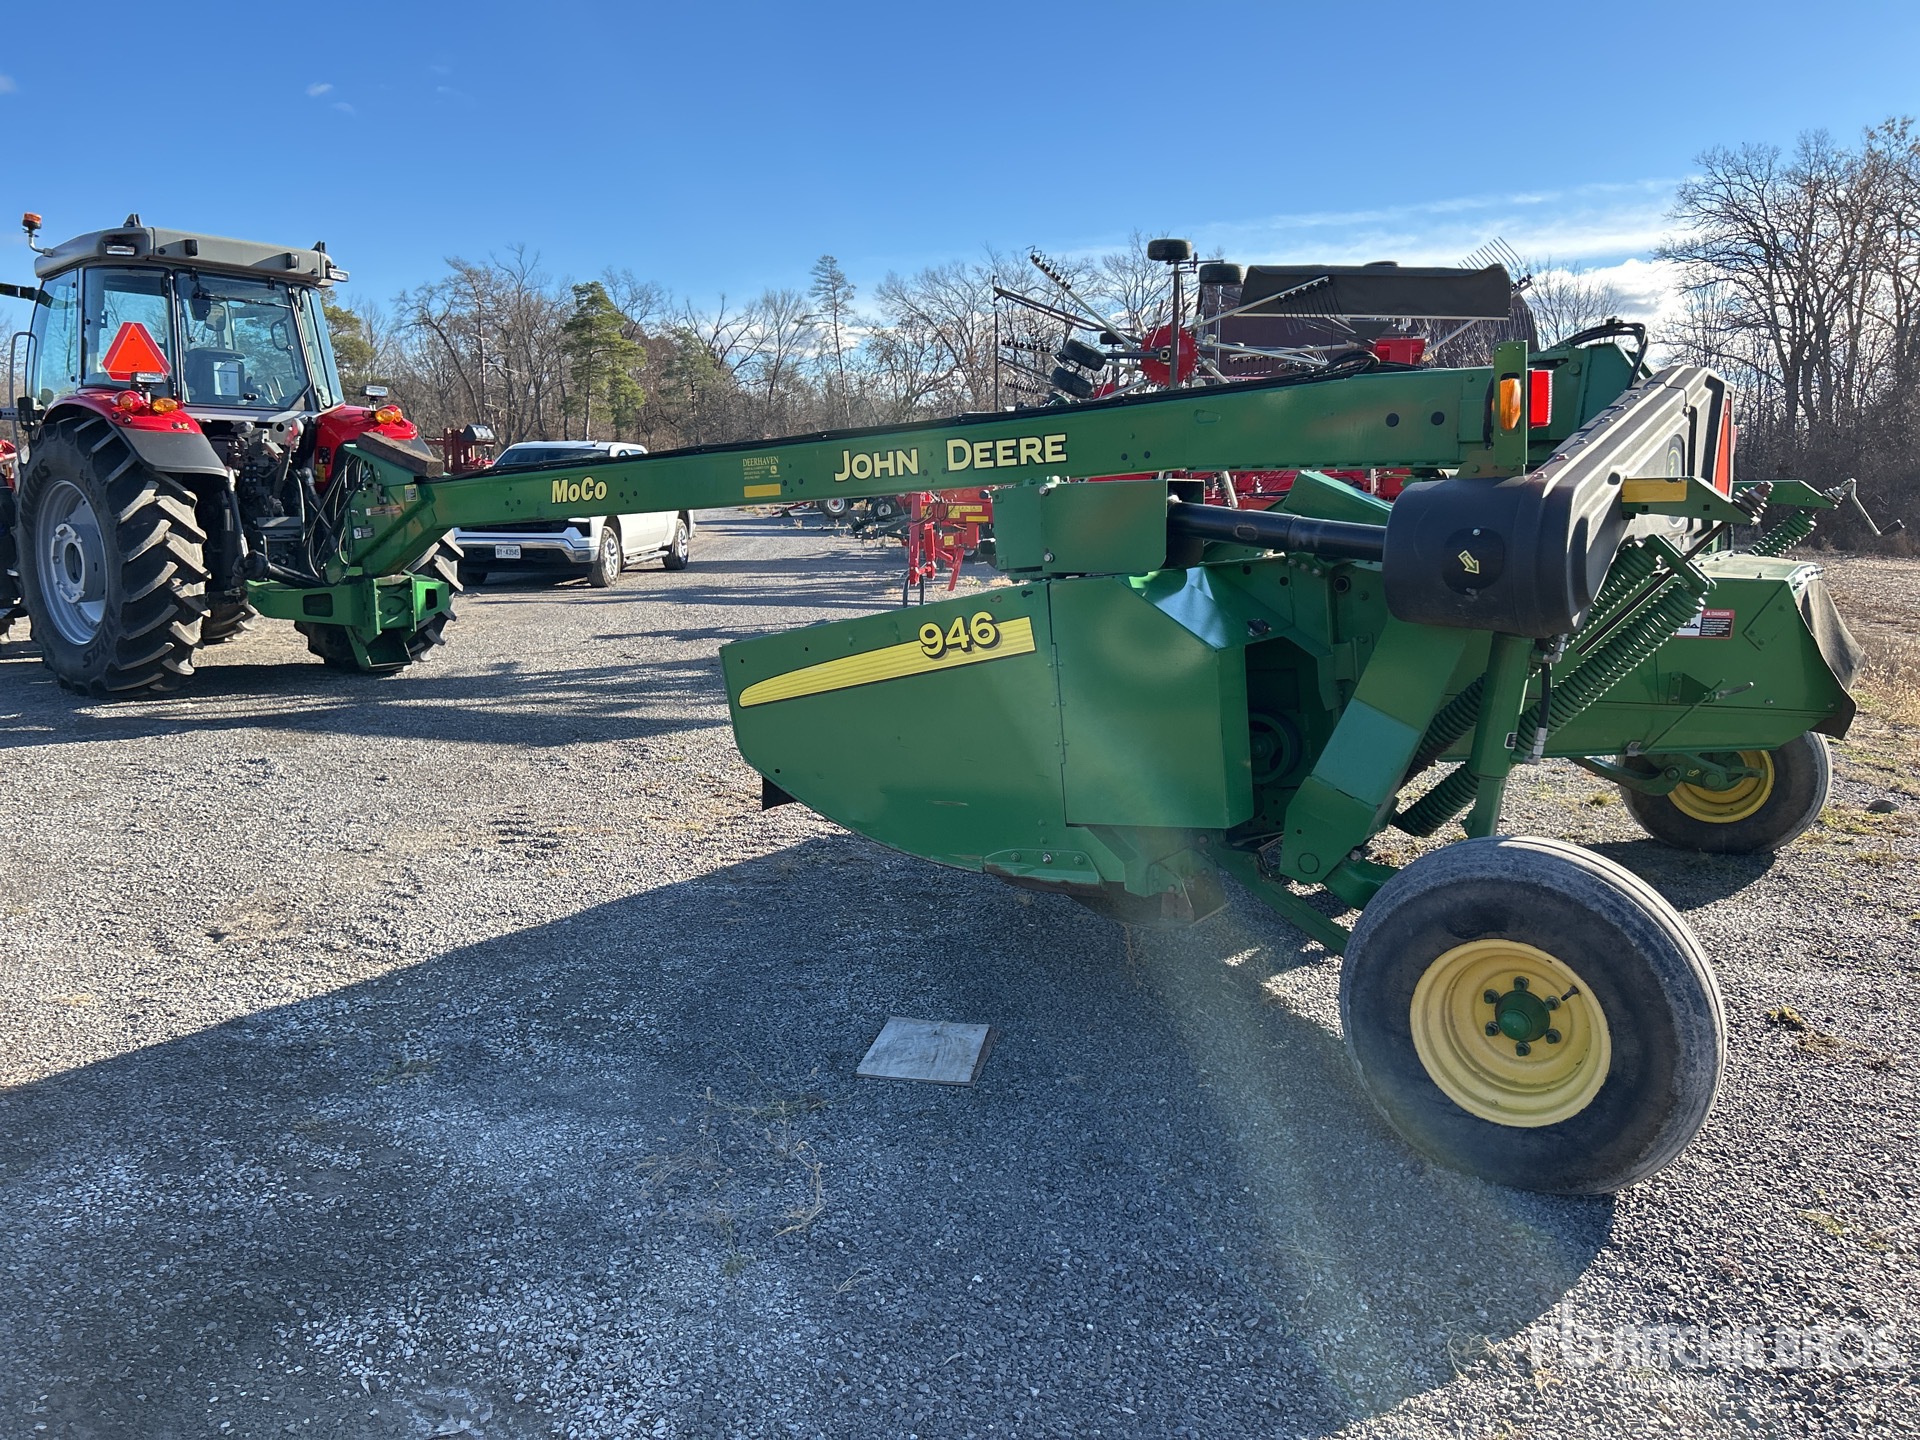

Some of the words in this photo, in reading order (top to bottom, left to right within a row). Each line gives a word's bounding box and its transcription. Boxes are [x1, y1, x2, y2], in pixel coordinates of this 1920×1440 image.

[742, 456, 779, 467] DEERHAVEN
[834, 449, 919, 482] JOHN
[946, 433, 1067, 472] DEERE
[551, 477, 607, 503] MoCo
[919, 611, 998, 657] 946
